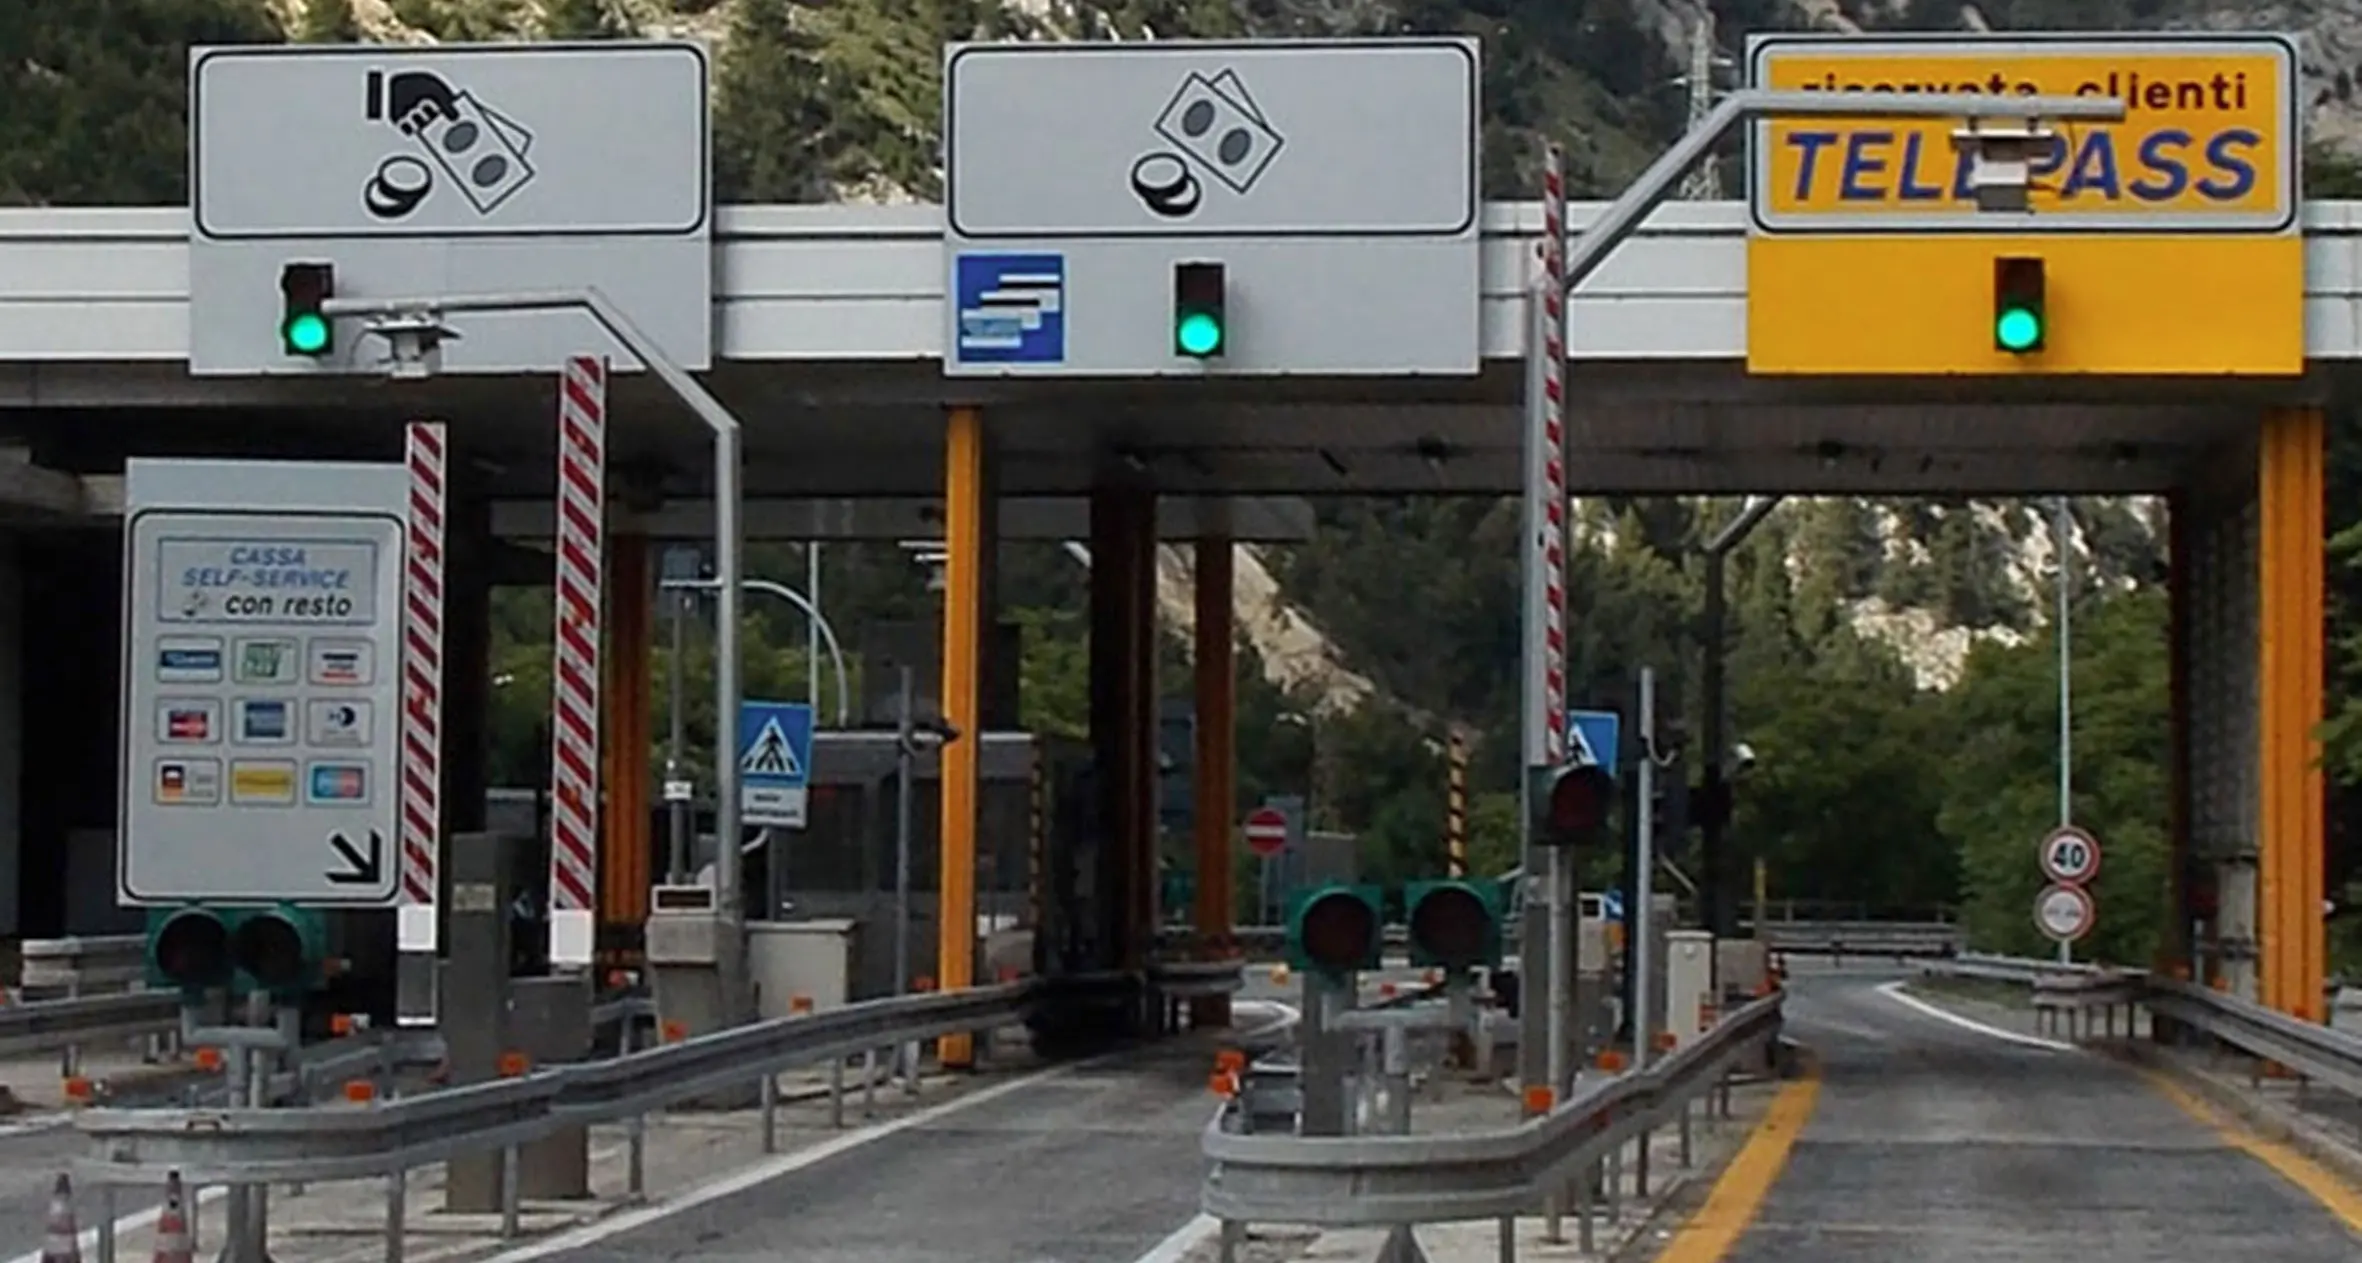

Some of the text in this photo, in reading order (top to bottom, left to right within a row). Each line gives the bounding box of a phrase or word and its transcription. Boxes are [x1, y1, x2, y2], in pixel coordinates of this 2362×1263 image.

[230, 547, 306, 566] CASSA
[182, 567, 349, 589] SELF-SERVICE
[225, 593, 353, 617] con resto
[2053, 843, 2085, 869] 40
